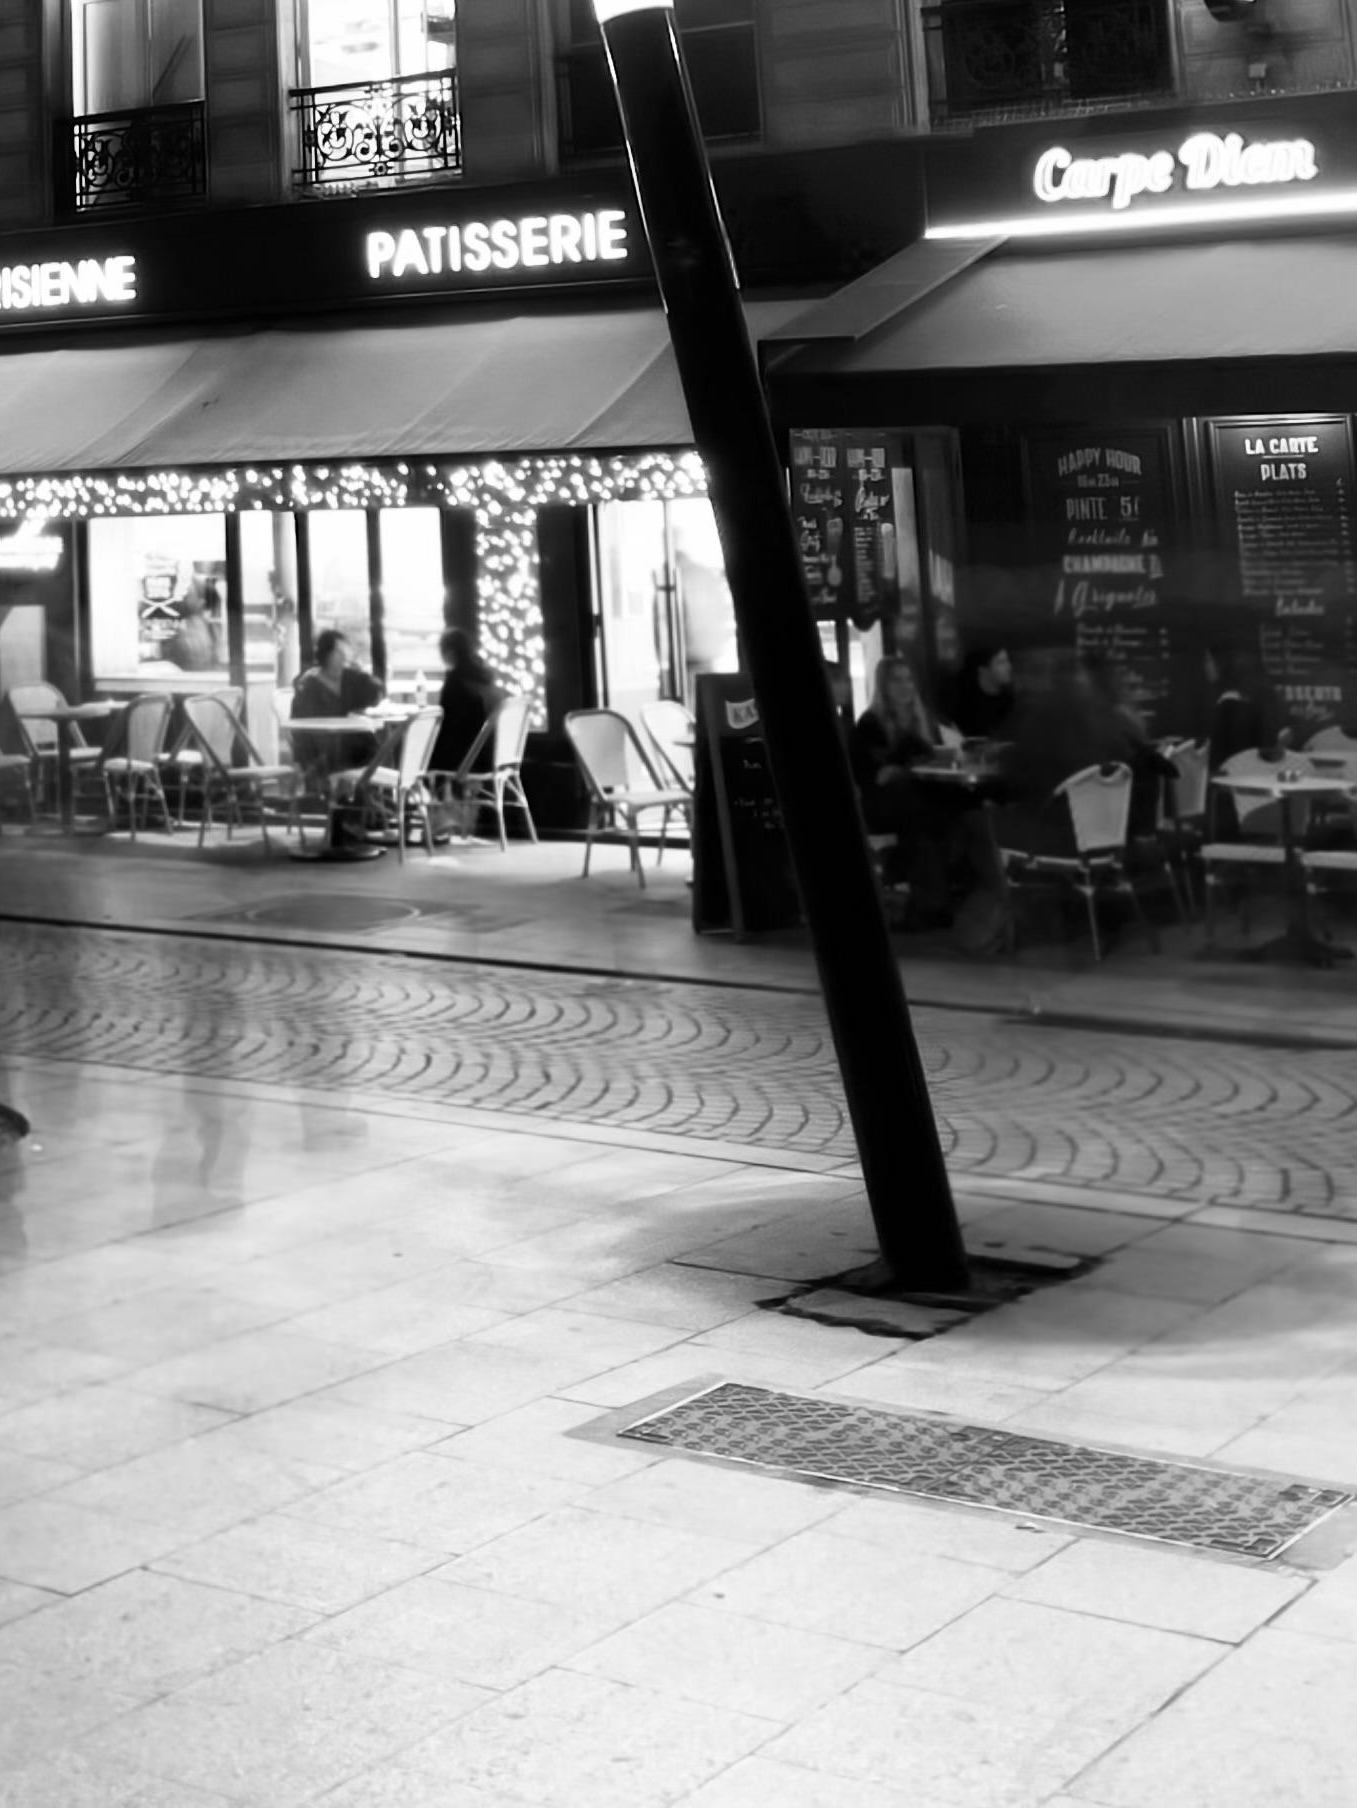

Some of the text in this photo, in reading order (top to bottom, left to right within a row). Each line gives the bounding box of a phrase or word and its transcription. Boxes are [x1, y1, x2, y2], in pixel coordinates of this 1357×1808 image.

[1033, 132, 1318, 210] Carpe Diem
[366, 210, 628, 279] PATISSERIE
[1244, 435, 1320, 455] LA CARTE
[1057, 447, 1142, 477] HAPPY HOUR
[1260, 462, 1308, 482] PLATS
[1065, 497, 1108, 520] PINTE
